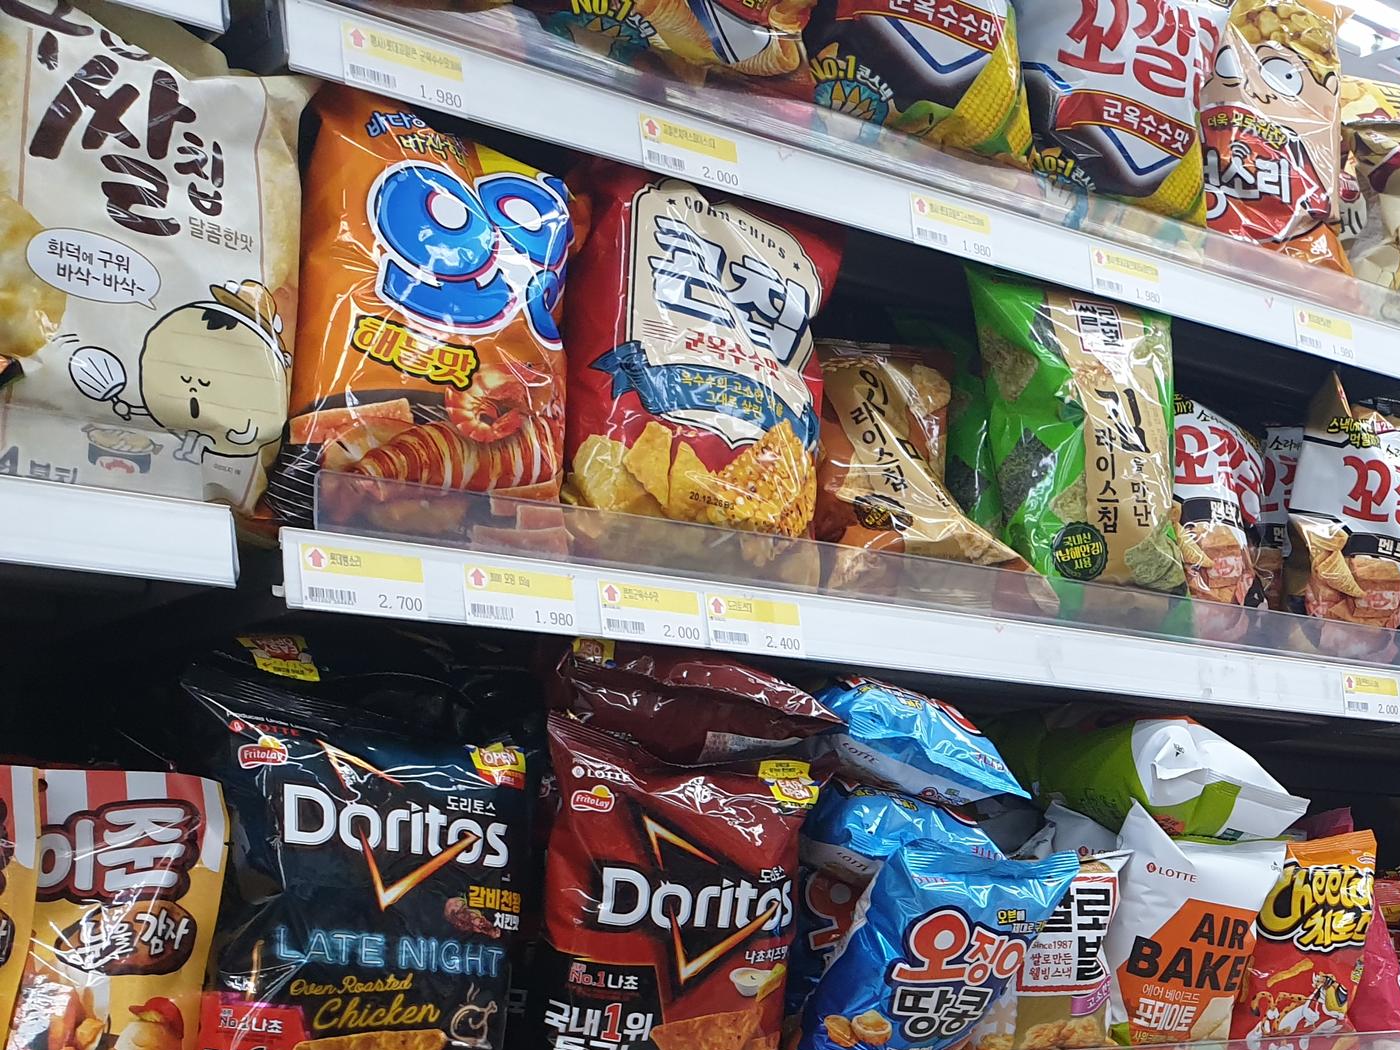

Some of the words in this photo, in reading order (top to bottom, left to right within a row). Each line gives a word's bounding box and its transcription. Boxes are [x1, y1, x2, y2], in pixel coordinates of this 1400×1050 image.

[1102, 100, 1192, 152] 군옥수수맛
[188, 216, 254, 254] 달콤한맛
[733, 214, 787, 261] CHIPS
[47, 237, 95, 265] 화덕에
[97, 249, 132, 273] 구워
[350, 314, 480, 390] 해물맛
[378, 594, 423, 612] 2.700
[535, 609, 574, 628] 1.980
[663, 624, 701, 642] 2.000
[765, 634, 801, 652] 2.400
[446, 795, 498, 819] 도리토스
[282, 782, 511, 871] Doritos
[1160, 865, 1198, 884] LOTTE
[597, 866, 793, 931] Doritos
[1190, 911, 1250, 949] AIR
[274, 923, 387, 968] LATE
[398, 935, 505, 978] NIGHT
[289, 977, 337, 998] Oven
[337, 971, 414, 996] Roasted
[312, 994, 442, 1031] Chicken
[897, 986, 994, 1037] 땅콩
[1132, 1000, 1198, 1032] 포테이토
